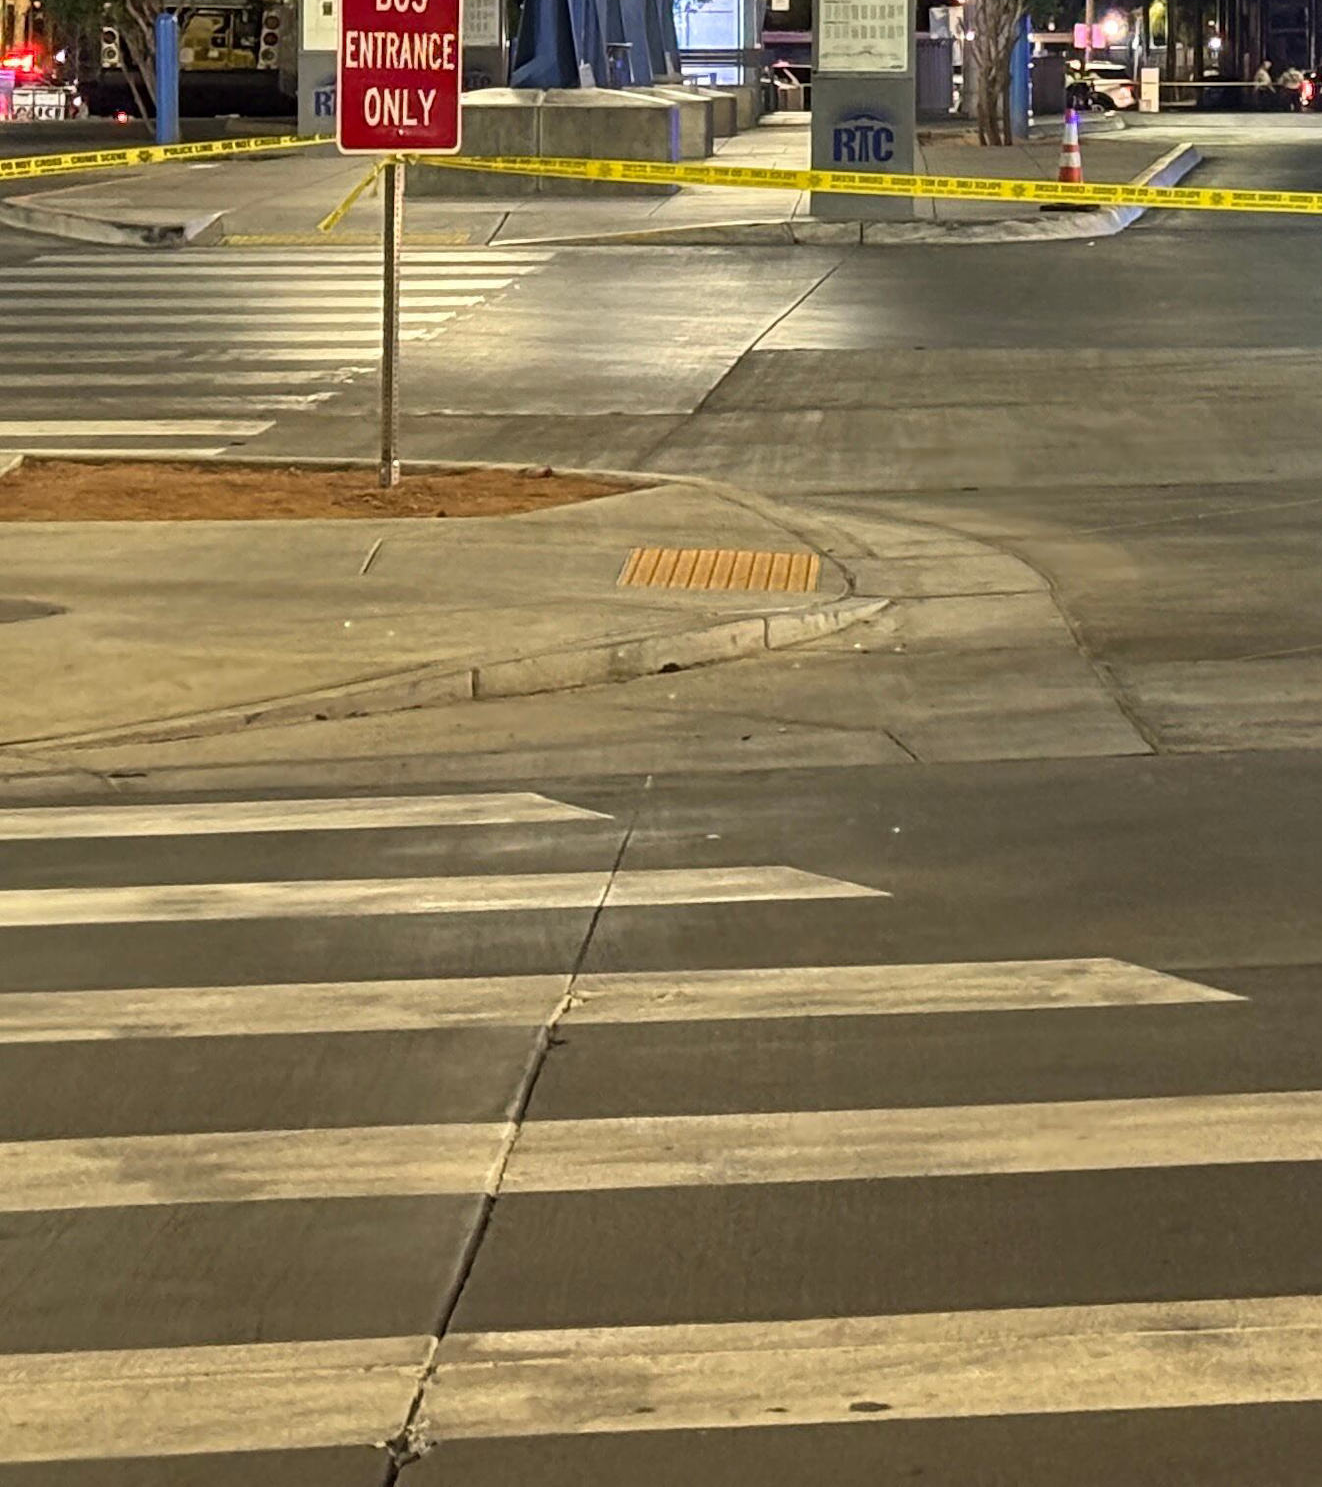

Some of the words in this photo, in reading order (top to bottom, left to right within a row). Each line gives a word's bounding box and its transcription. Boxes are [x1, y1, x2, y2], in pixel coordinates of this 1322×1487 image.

[345, 30, 456, 70] ENTRANCE
[363, 86, 437, 128] ONLY
[833, 125, 894, 163] RTC
